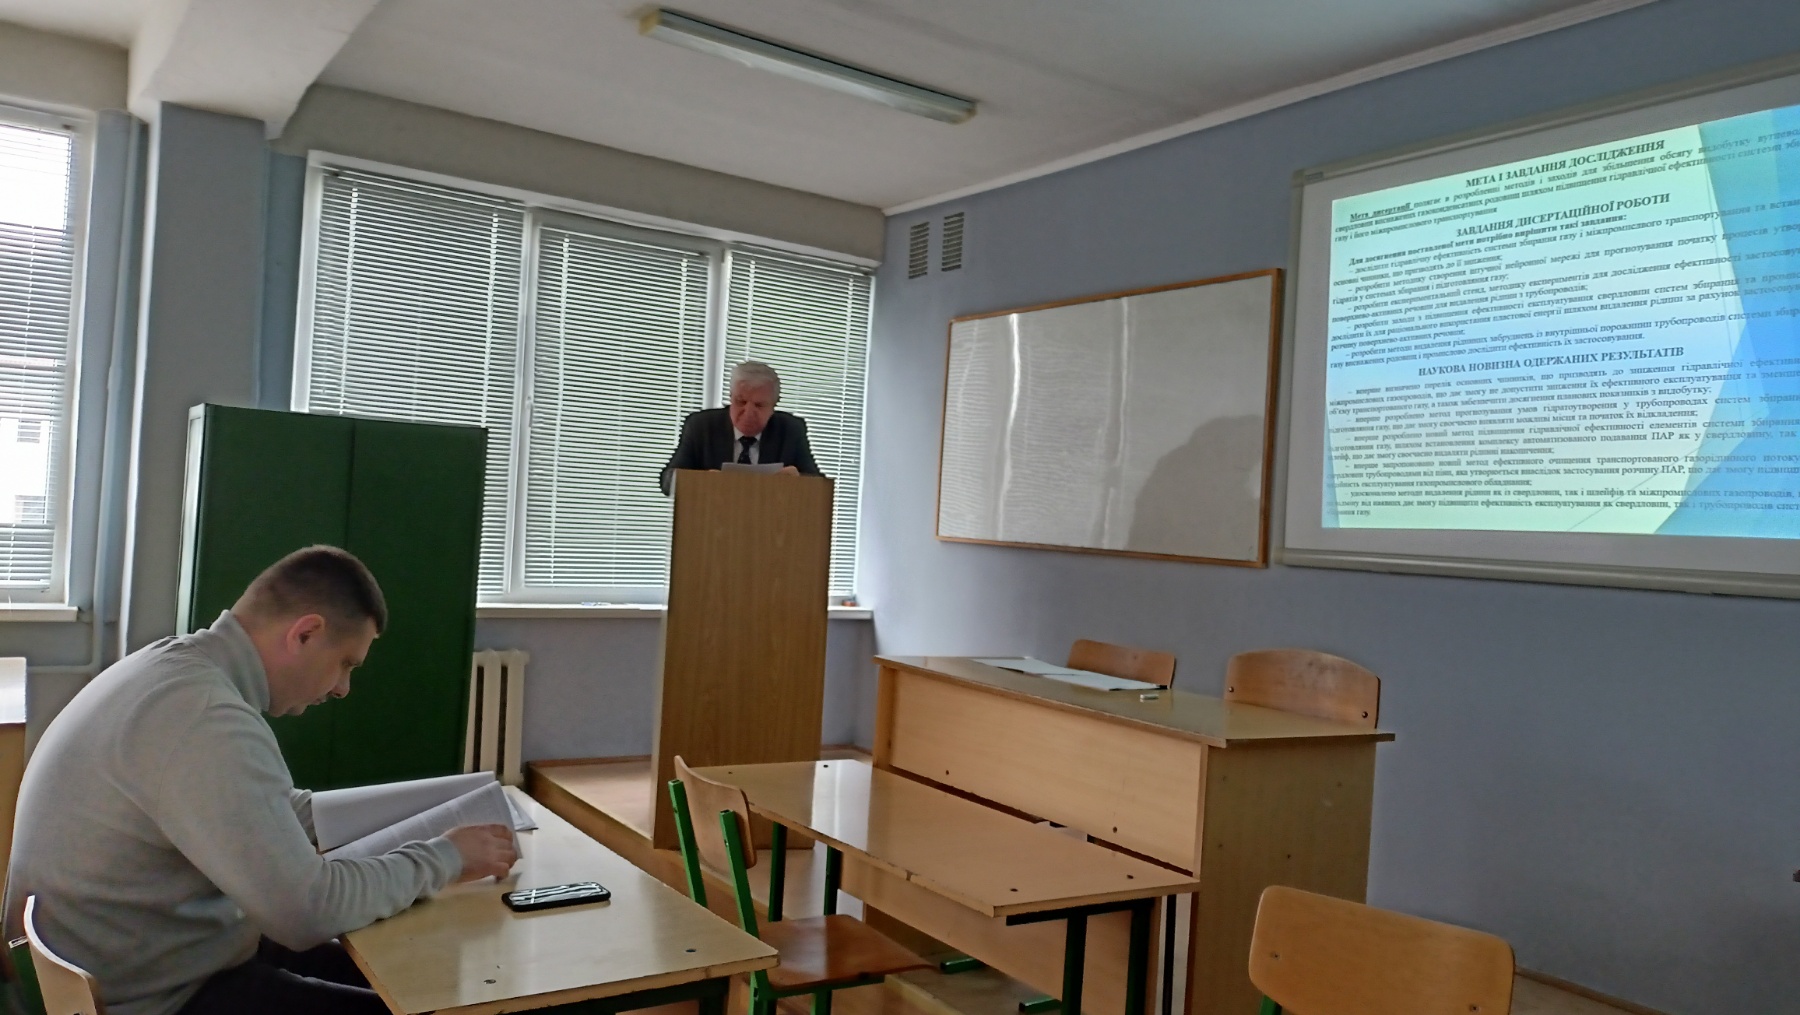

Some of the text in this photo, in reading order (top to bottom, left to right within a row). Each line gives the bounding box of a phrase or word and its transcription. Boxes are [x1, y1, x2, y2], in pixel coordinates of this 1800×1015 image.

[1465, 173, 1495, 188] МЕТА
[1505, 159, 1566, 180] ЗАВДАННЯ
[1568, 139, 1665, 169] ДОСЛІДЖЕННЯ
[1581, 166, 1597, 177] для
[1659, 148, 1692, 161] обсягу
[1456, 192, 1670, 237] ЗАВДАННЯ ДИСЕРТАЦІЙНОЇ РОБОТИ
[1550, 251, 1580, 264] мережі
[1584, 250, 1600, 260] для
[1677, 233, 1717, 246] початку
[1591, 271, 1608, 281] для
[1685, 293, 1696, 302] за
[1418, 345, 1684, 376] НАУКОВА НОВИЗНА ОДЕРЖАНИХ РЕЗУЛЬТАТІВ
[1611, 368, 1624, 377] до
[1651, 431, 1675, 440] ПАР
[1678, 432, 1690, 440] як
